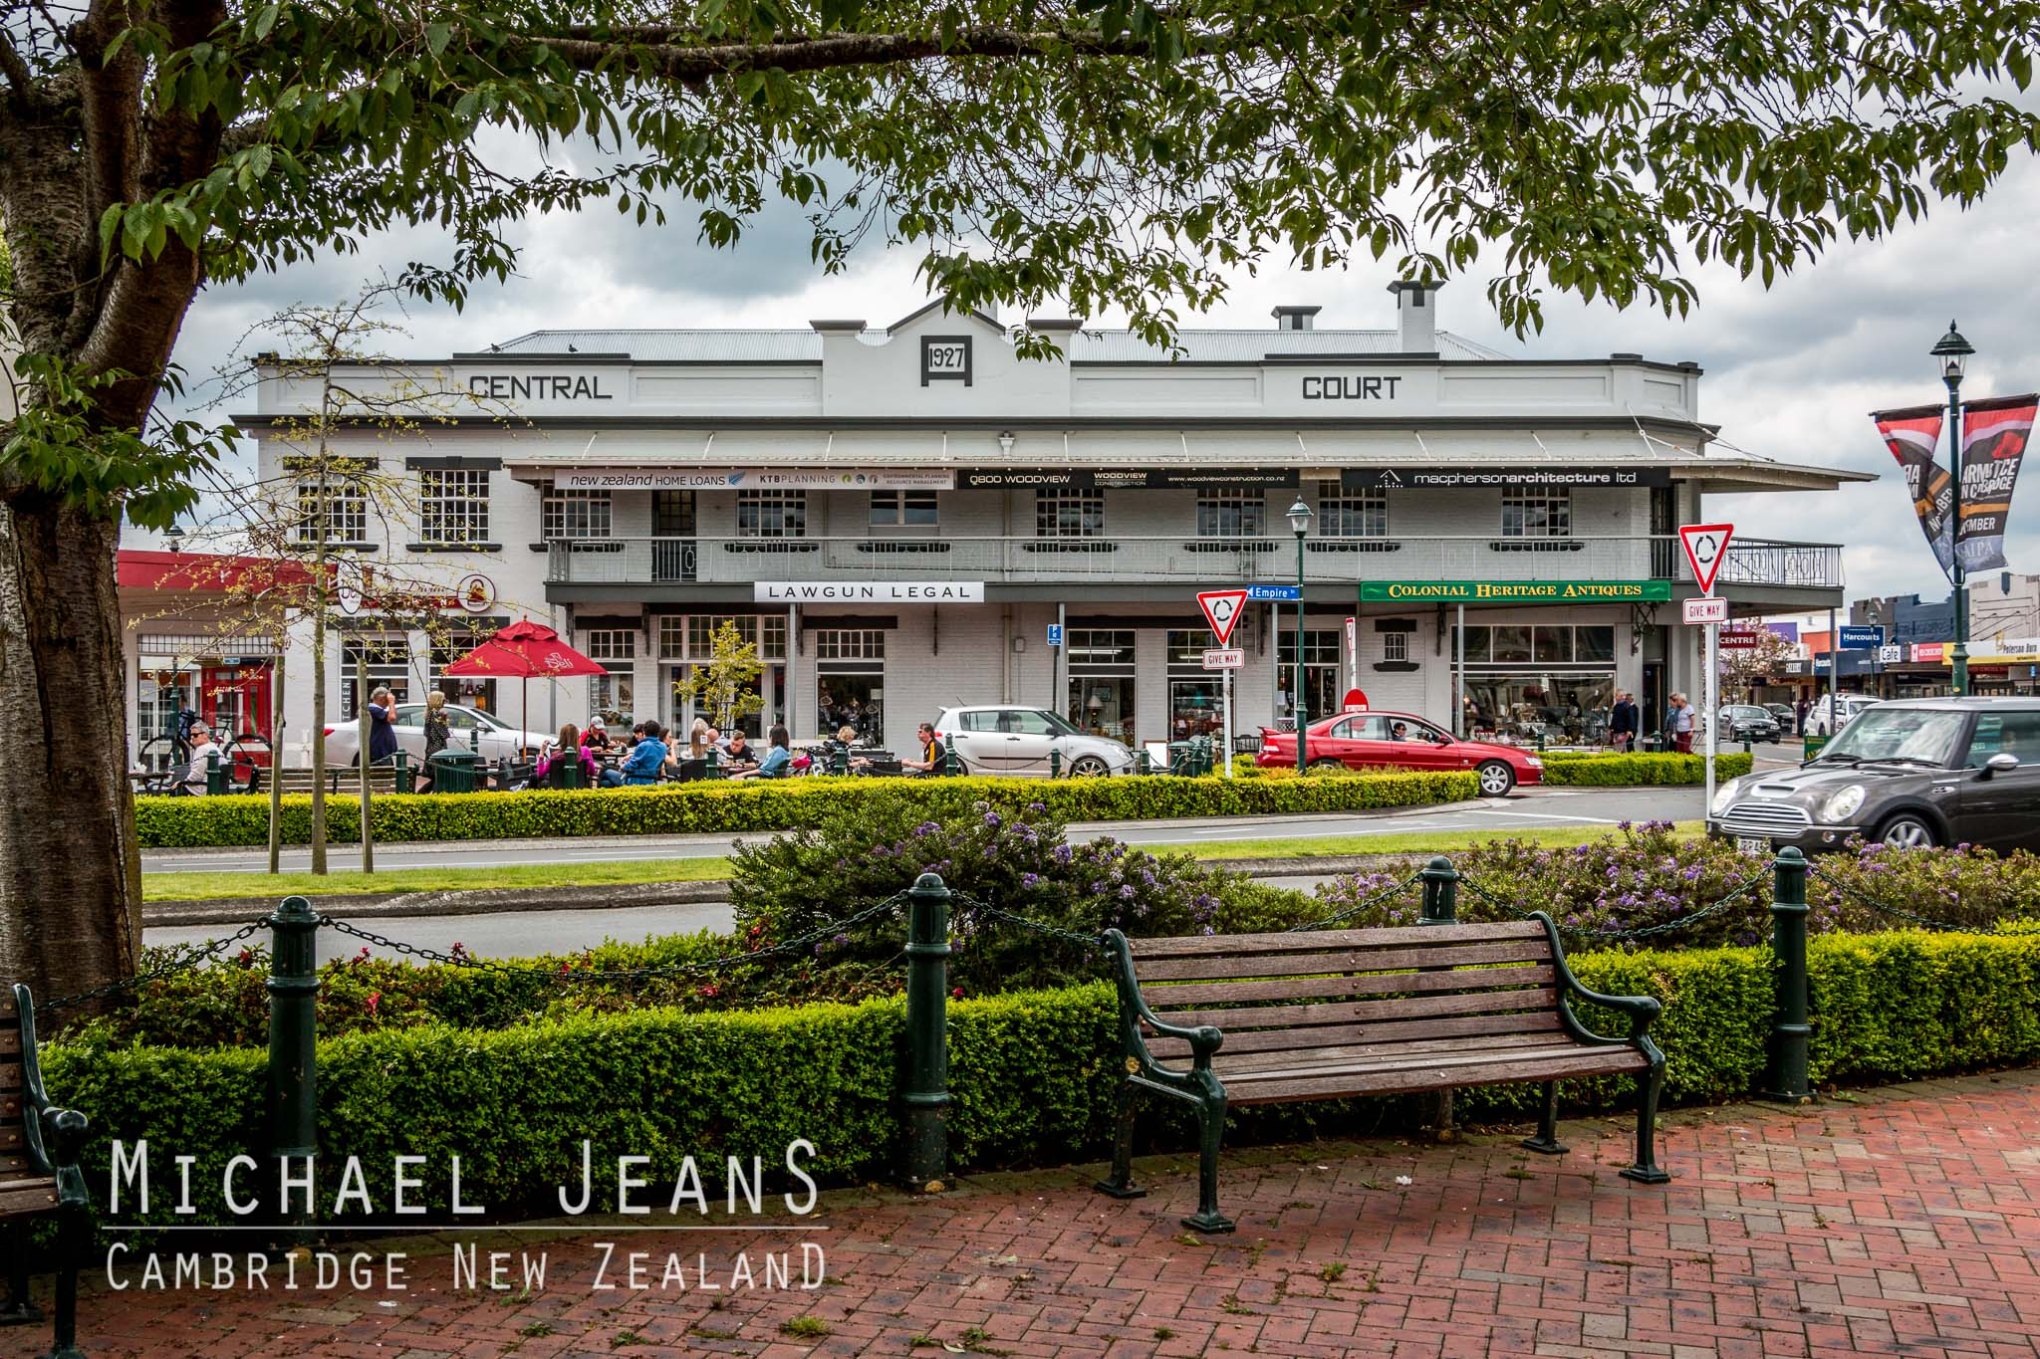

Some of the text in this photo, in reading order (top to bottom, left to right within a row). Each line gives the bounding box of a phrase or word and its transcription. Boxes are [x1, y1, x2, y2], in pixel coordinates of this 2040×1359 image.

[929, 347, 964, 367] 1927
[470, 376, 612, 399] CENTRAL
[1303, 377, 1402, 400] COURT
[570, 474, 726, 486] new zealand HOME LOANS
[1005, 475, 1071, 484] WOODVIEW
[1094, 472, 1147, 480] WOODVIEW
[1414, 472, 1636, 486] macphersonarchitecture ltd
[769, 586, 971, 598] LAWGUN LEGAL
[1256, 587, 1288, 598] Empire
[1690, 604, 1720, 617] GIVE WAY
[1720, 636, 1755, 644] CENTRE
[1208, 654, 1238, 664] GIVE WAY
